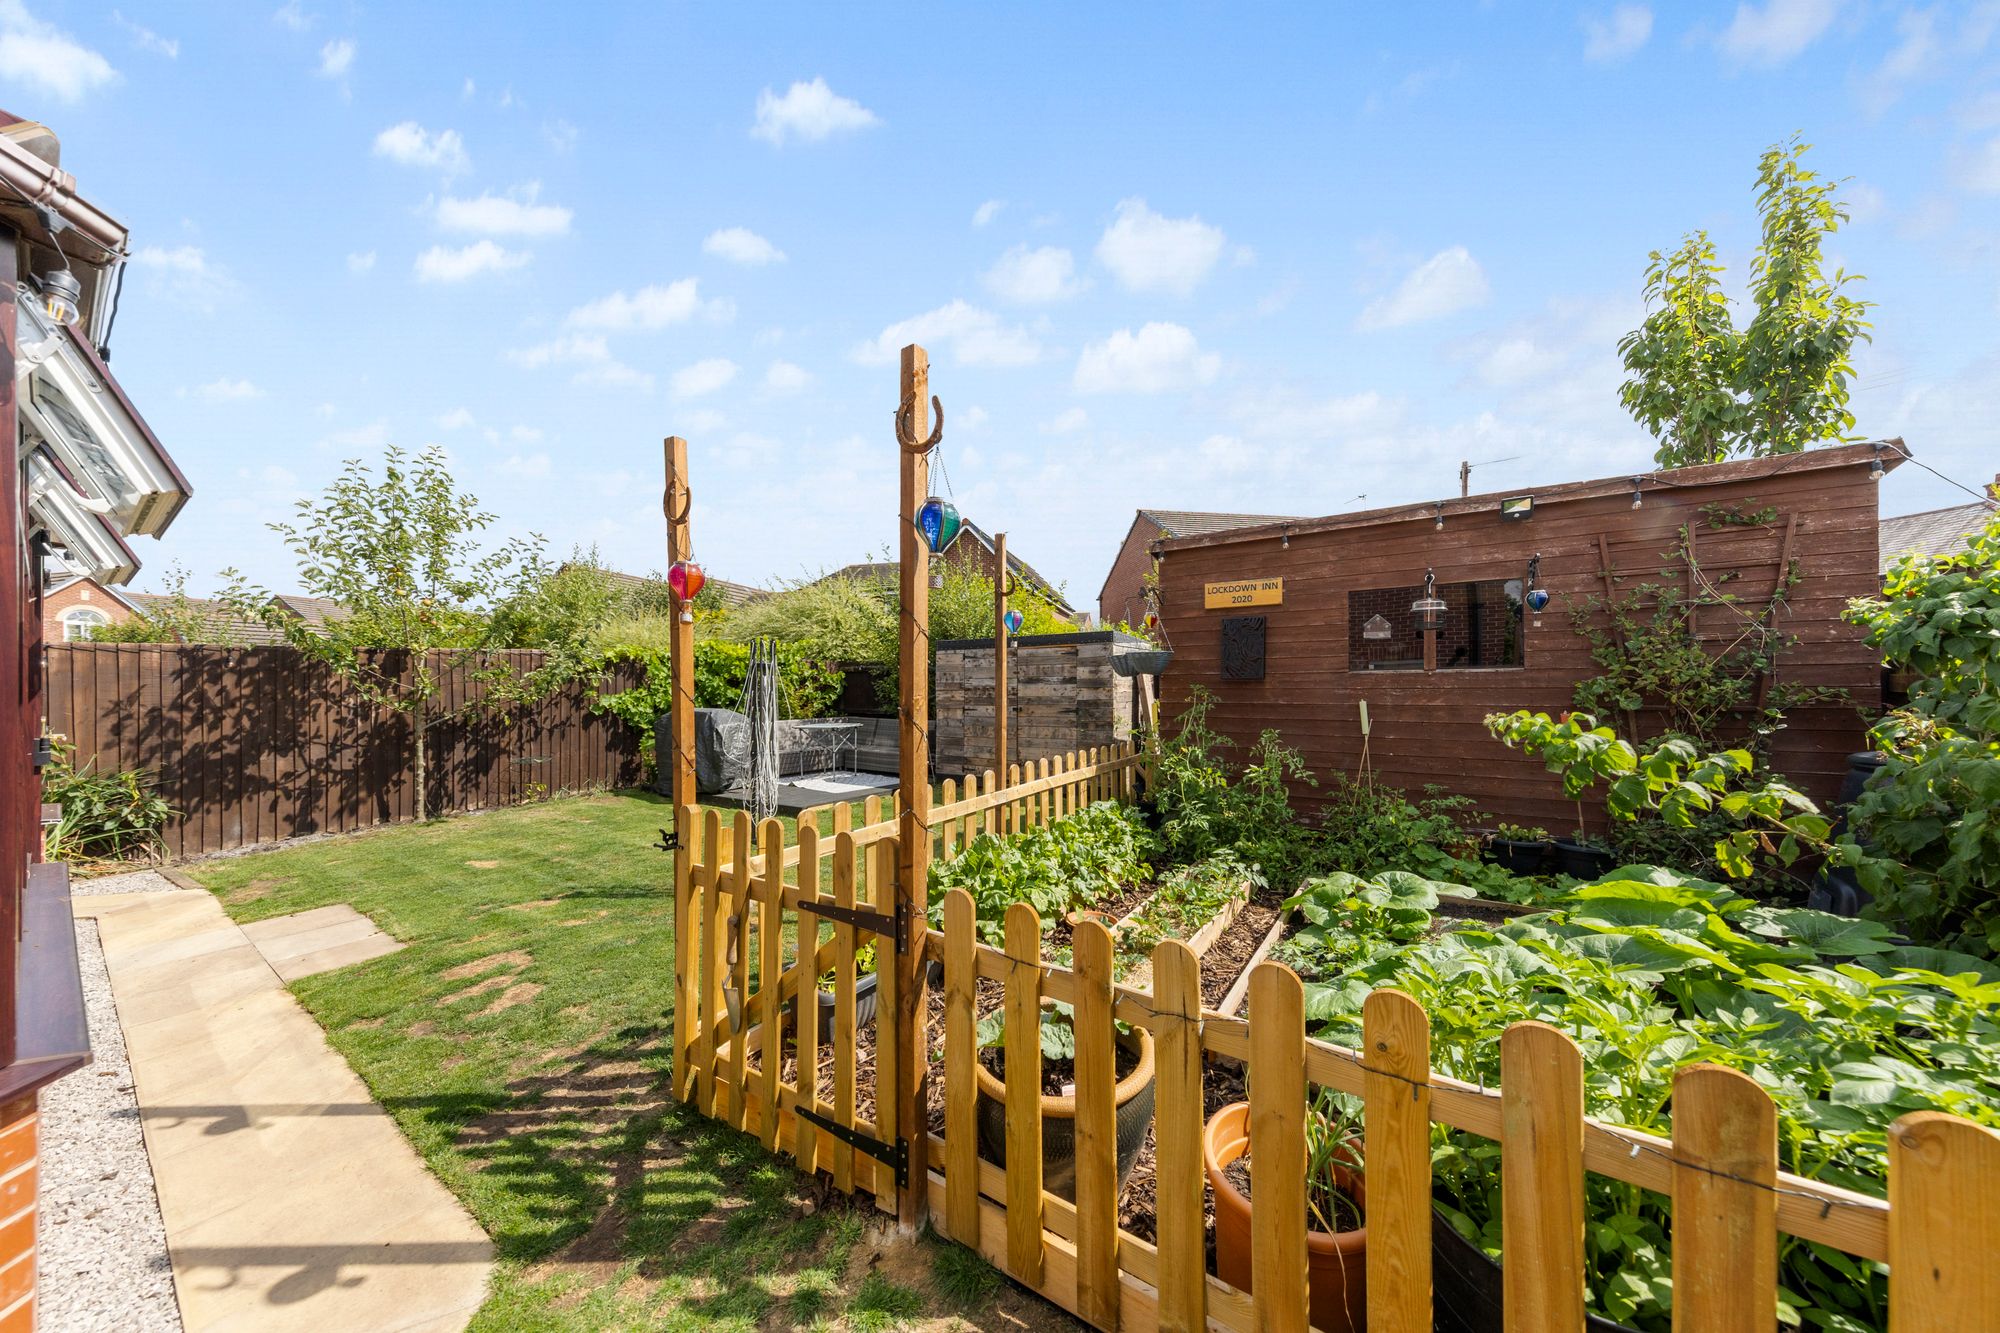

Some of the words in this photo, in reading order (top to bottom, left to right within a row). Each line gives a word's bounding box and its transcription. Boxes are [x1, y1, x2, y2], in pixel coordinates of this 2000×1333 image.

[1207, 584, 1257, 595] LOCKDOWN
[1262, 582, 1279, 590] INN
[1232, 595, 1253, 604] 2020
